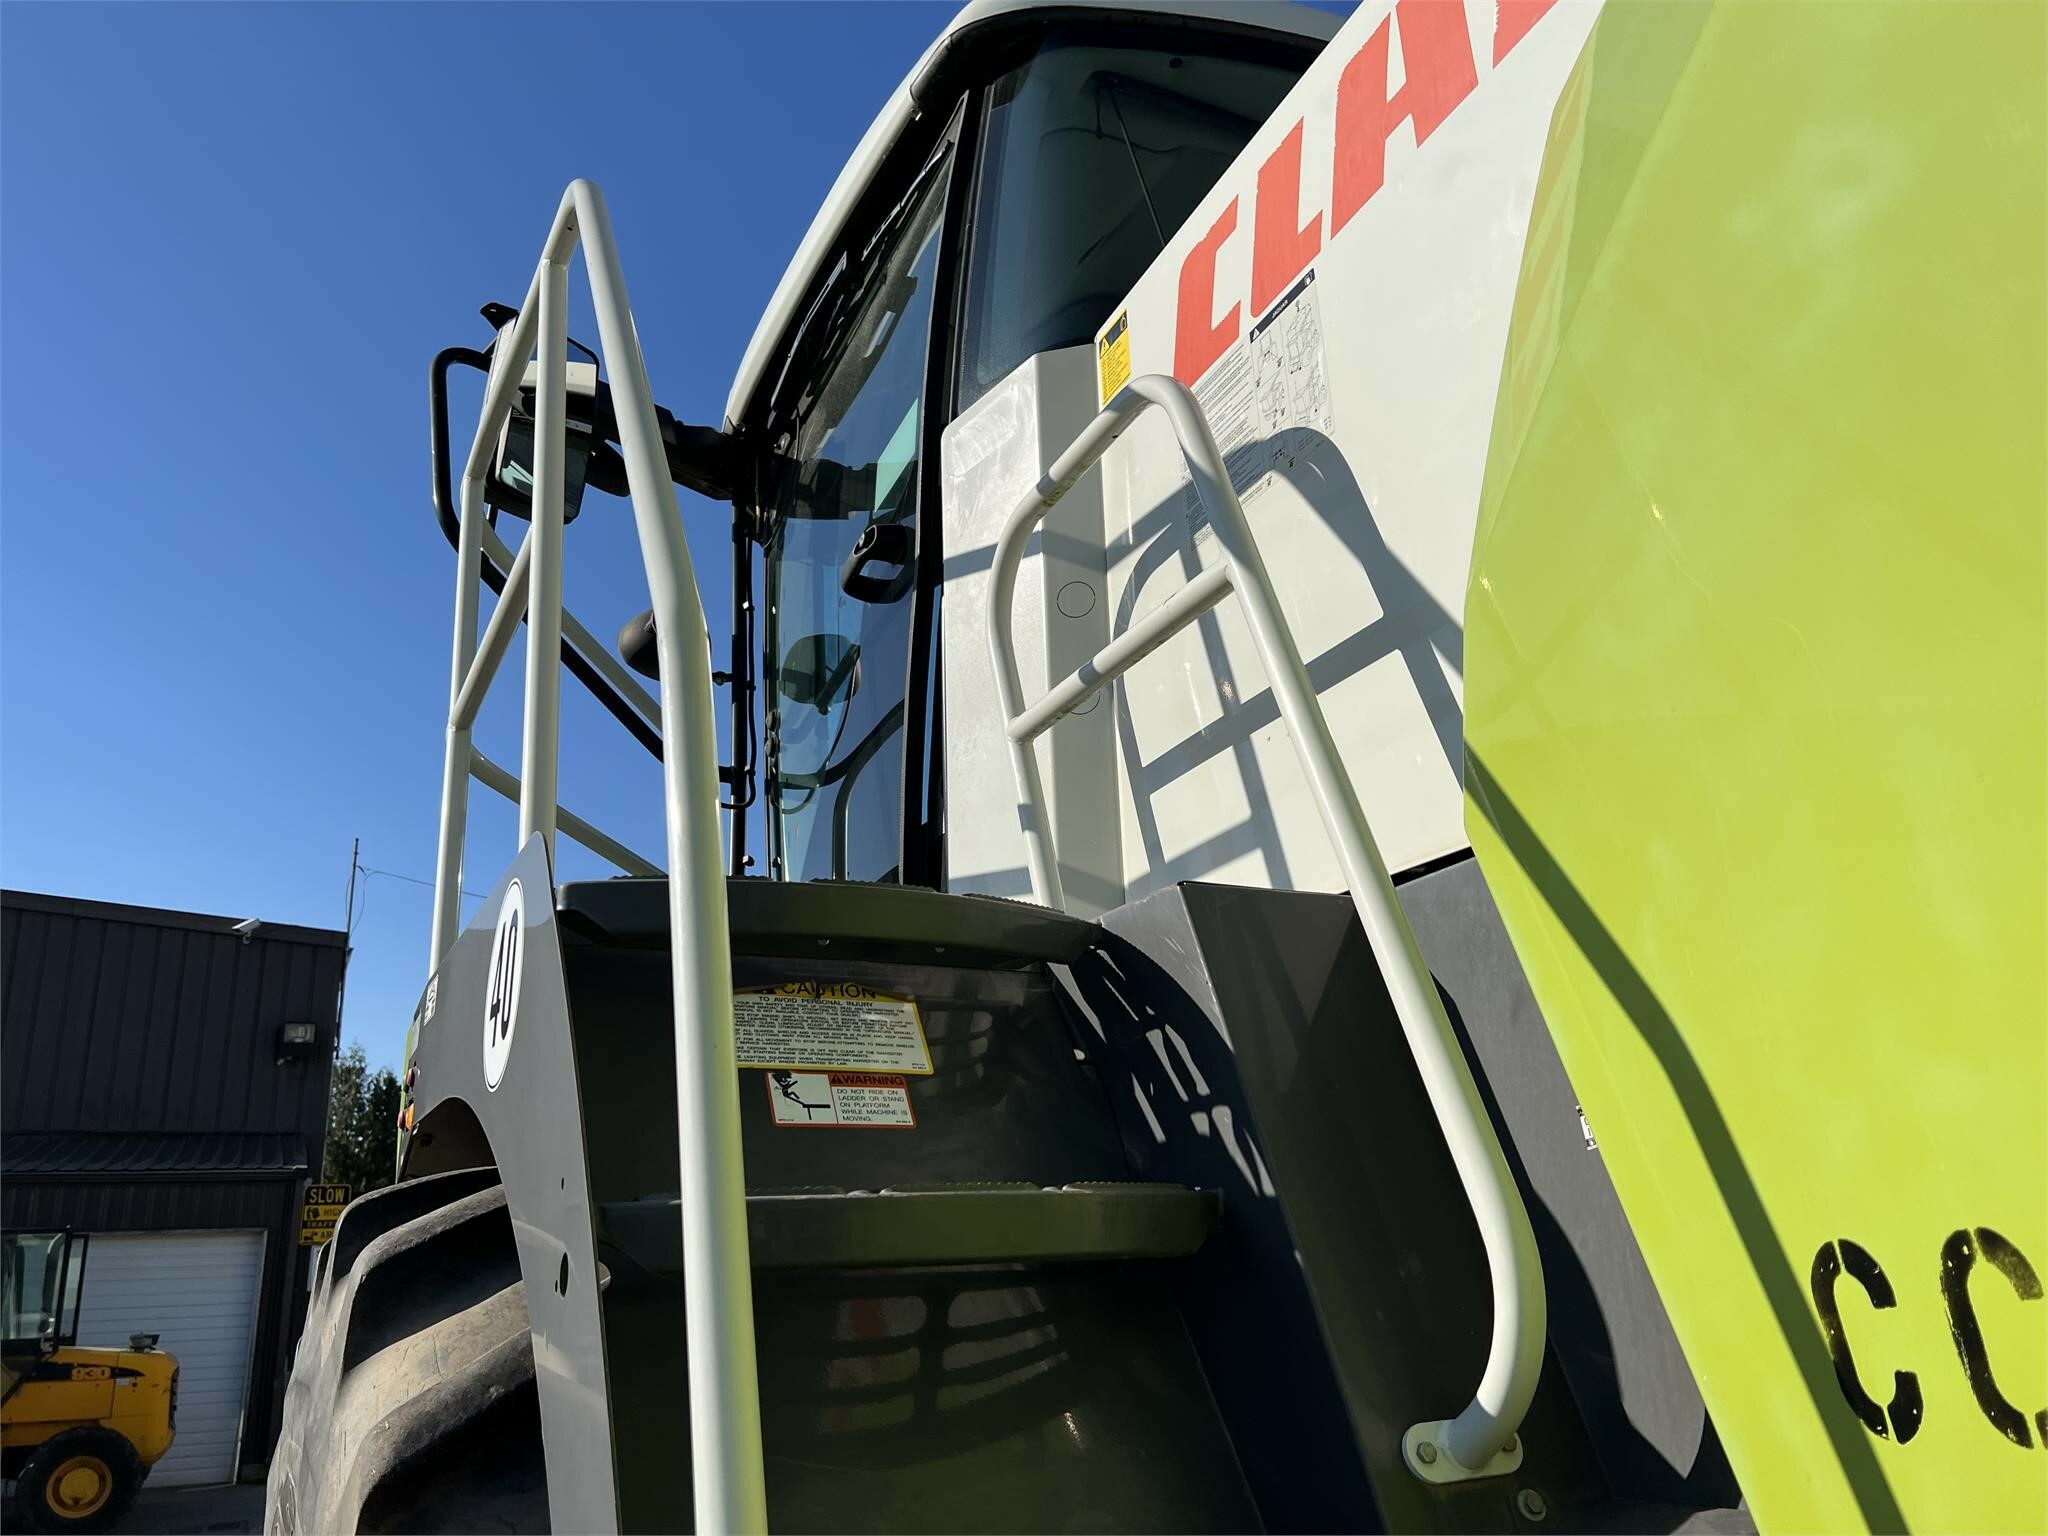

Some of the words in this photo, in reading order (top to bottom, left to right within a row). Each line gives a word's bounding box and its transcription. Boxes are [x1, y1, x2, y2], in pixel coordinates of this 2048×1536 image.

[1174, 0, 1558, 388] CLA
[489, 908, 519, 1049] 40
[842, 1075, 904, 1086] WARNING
[308, 1188, 346, 1204] SLOW
